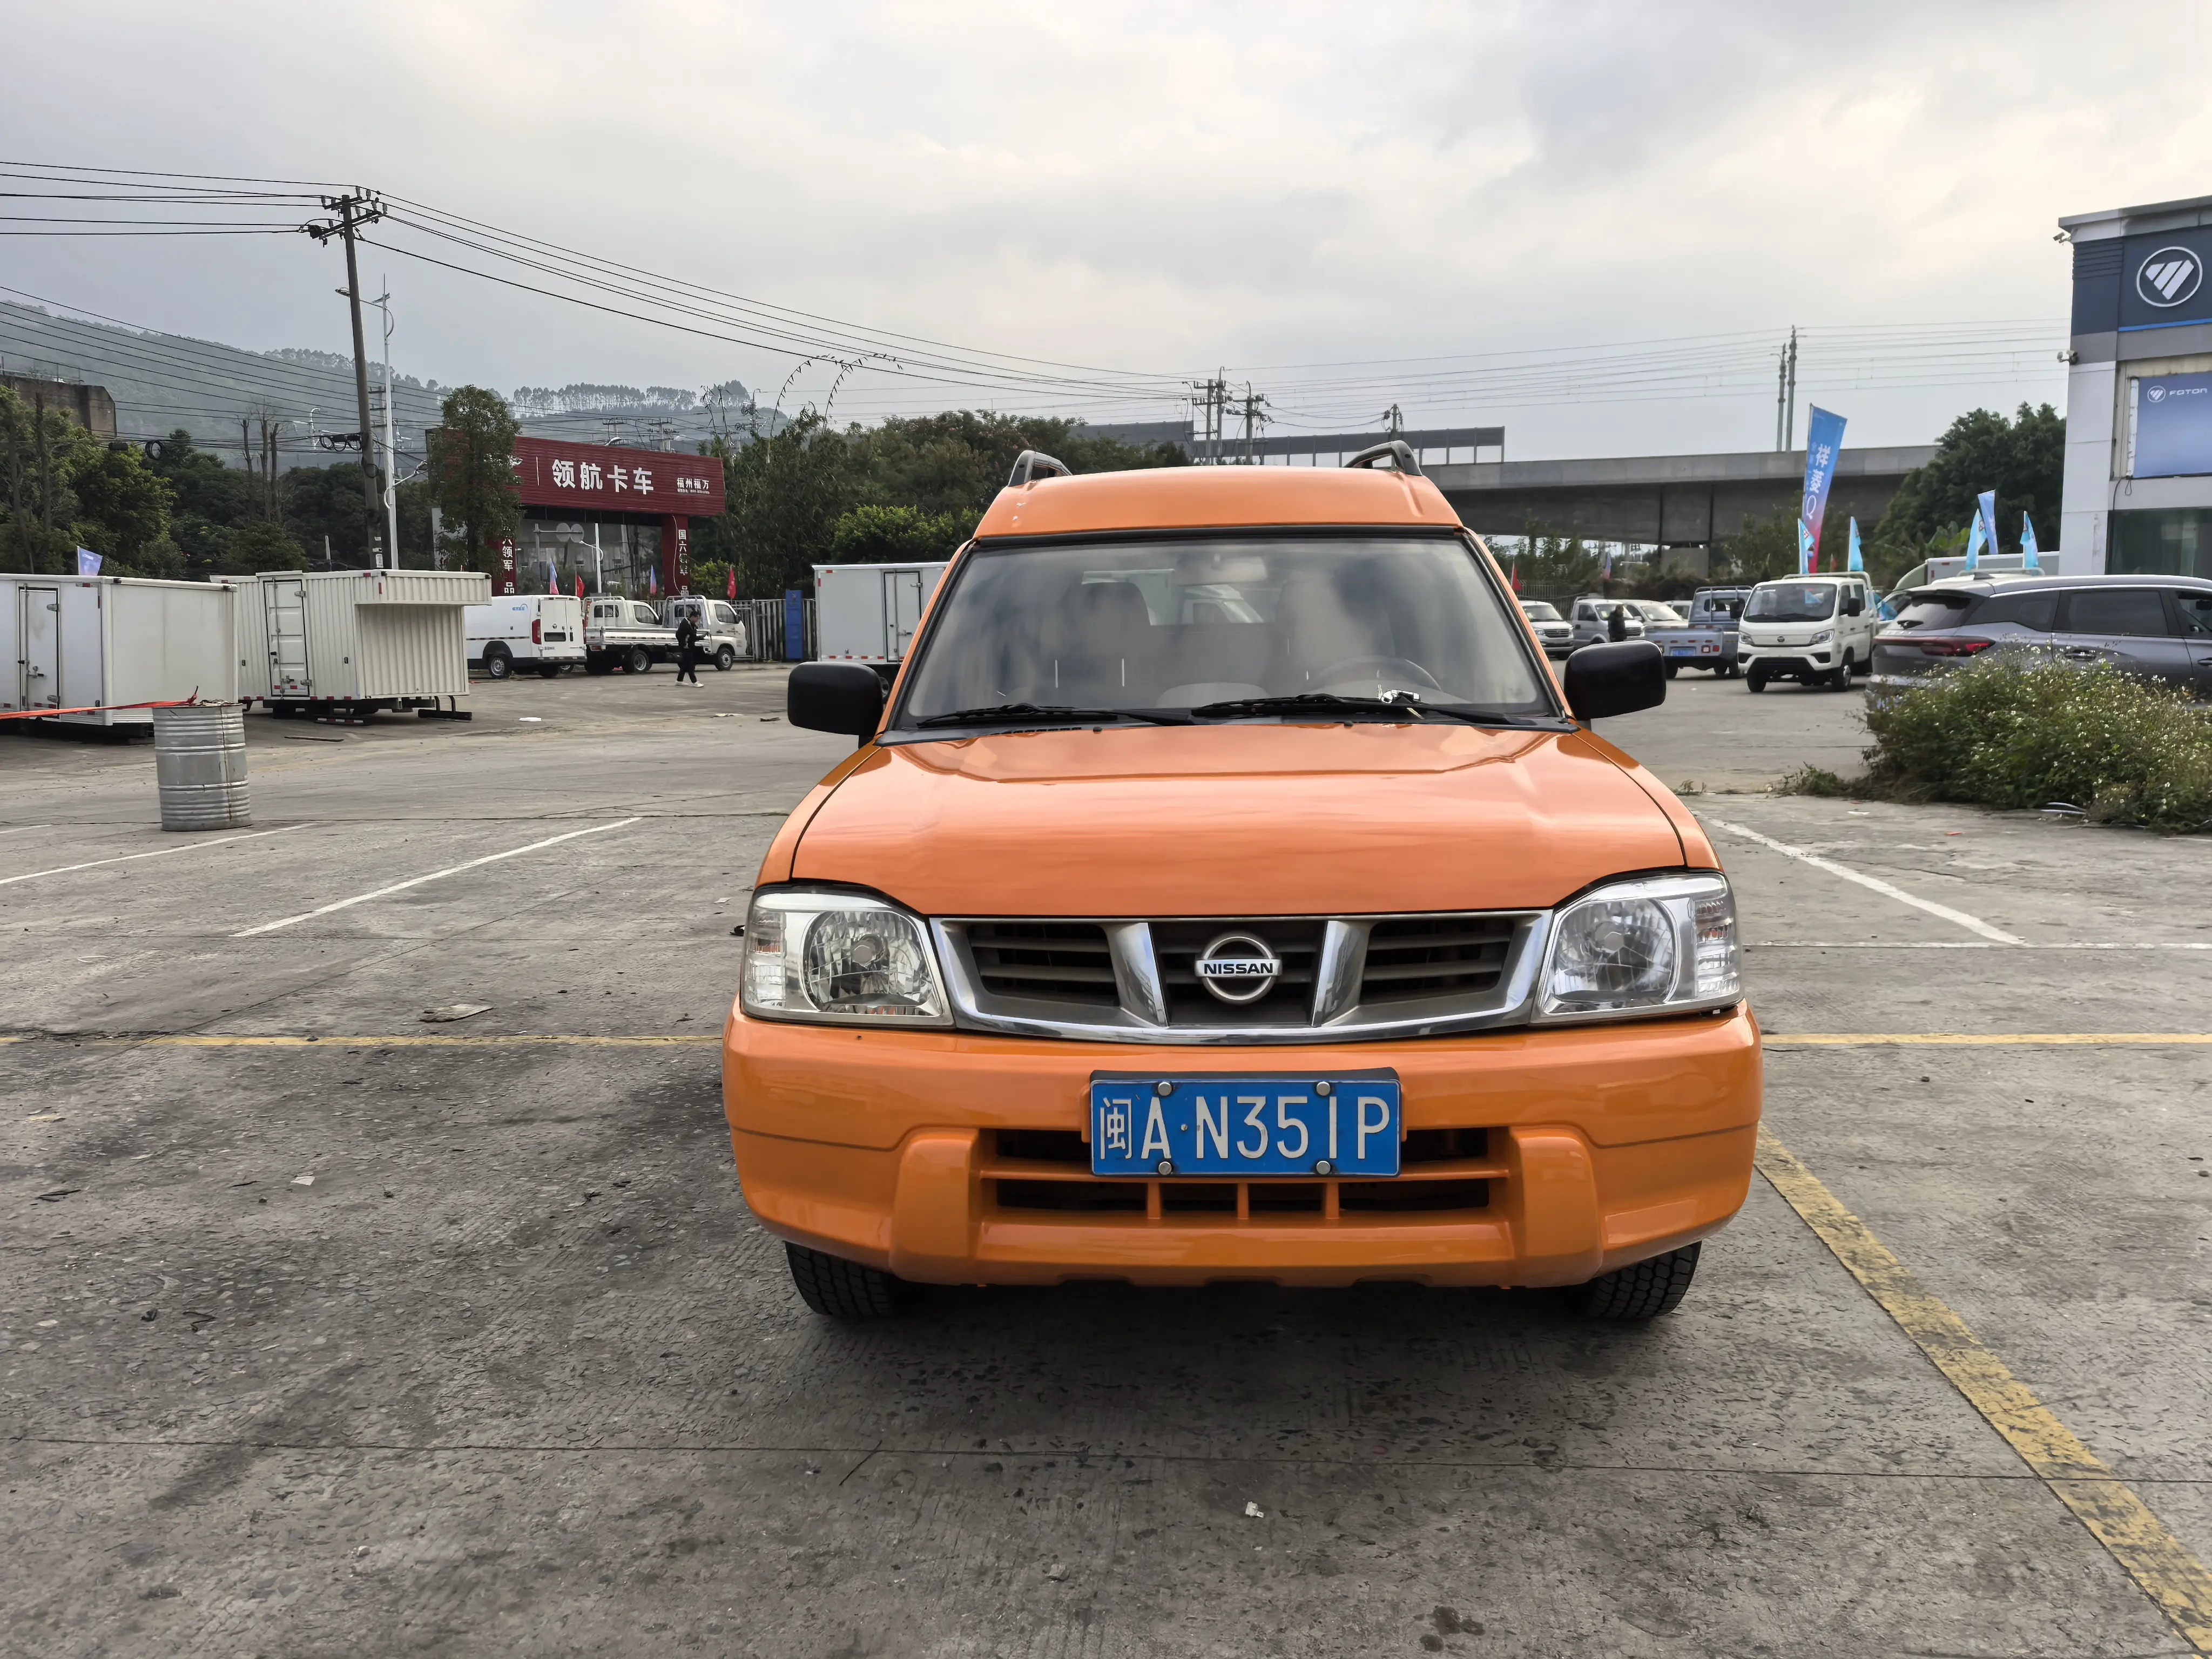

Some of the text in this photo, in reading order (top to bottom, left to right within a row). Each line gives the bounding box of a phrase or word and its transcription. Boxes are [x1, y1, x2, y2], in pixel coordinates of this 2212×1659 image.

[552, 459, 654, 495] 领航卡车
[677, 477, 710, 490] 福州福万
[1204, 963, 1273, 974] NISSAN
